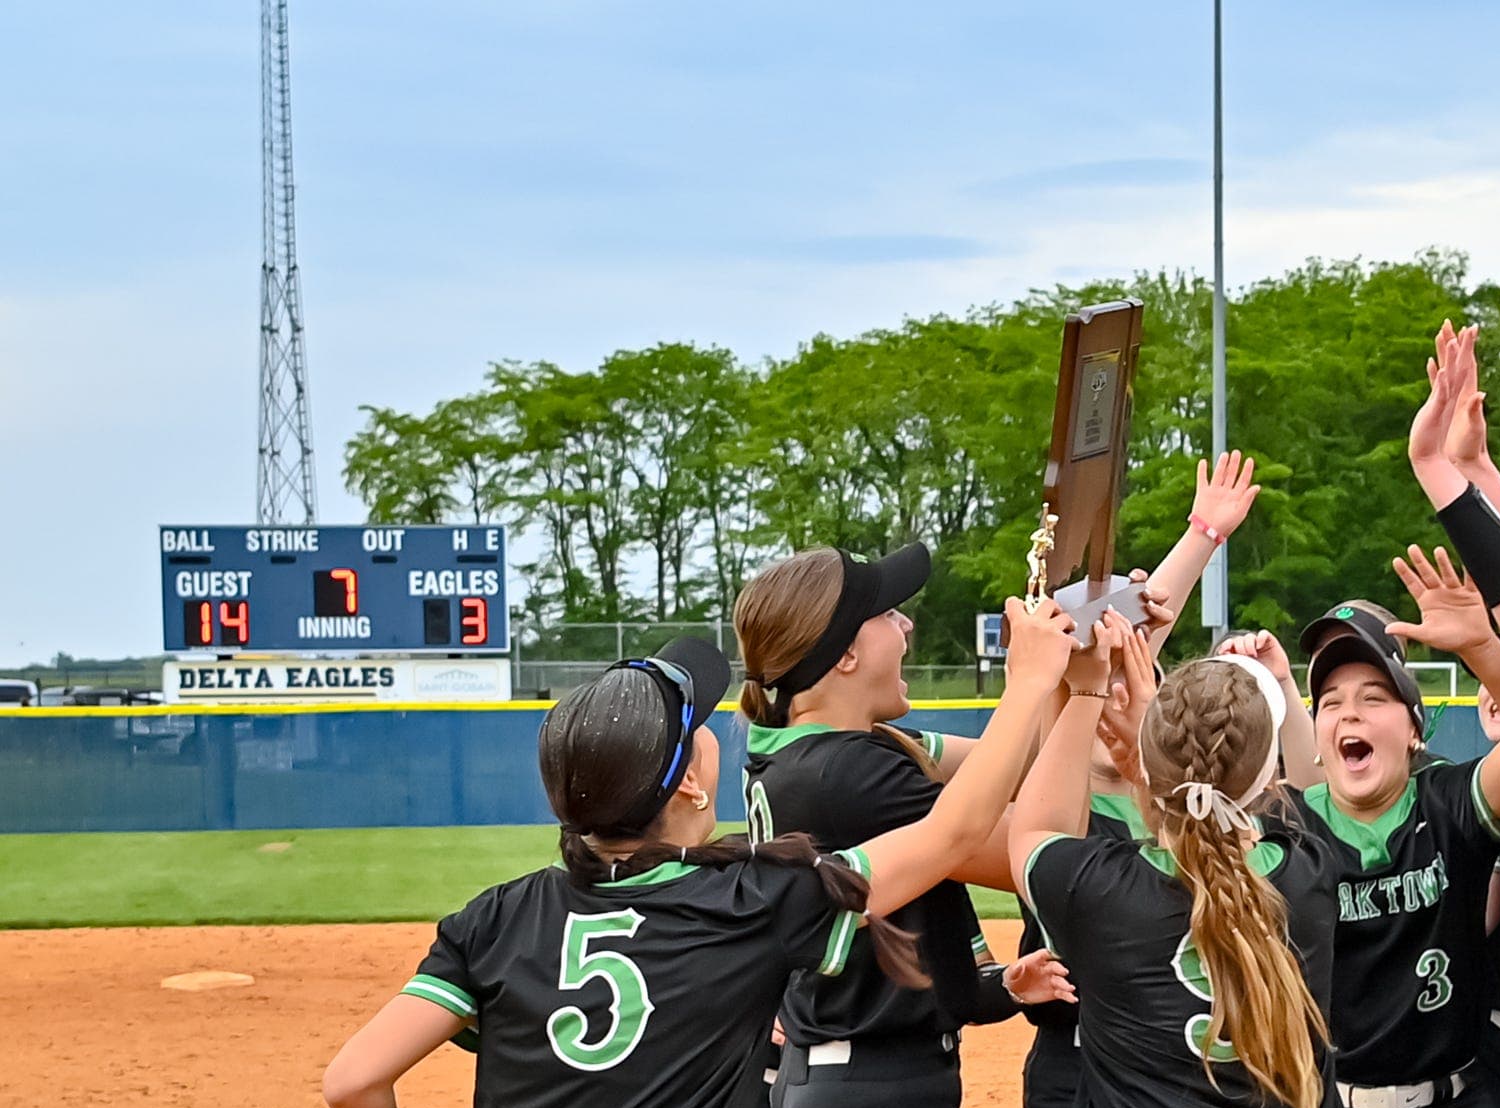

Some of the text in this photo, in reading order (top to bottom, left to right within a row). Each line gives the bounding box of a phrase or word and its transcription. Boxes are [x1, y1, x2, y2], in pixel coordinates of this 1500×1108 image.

[163, 529, 499, 551] BALL STRIKE OUT H E
[176, 571, 251, 597] GUEST
[330, 568, 357, 615] 7
[409, 571, 499, 596] EAGLES
[200, 601, 249, 644] 14
[299, 617, 371, 638] INNING
[461, 598, 487, 644] 3
[179, 667, 394, 688] DELTA EAGLES
[546, 907, 655, 1072] 5
[1415, 949, 1453, 1013] 3
